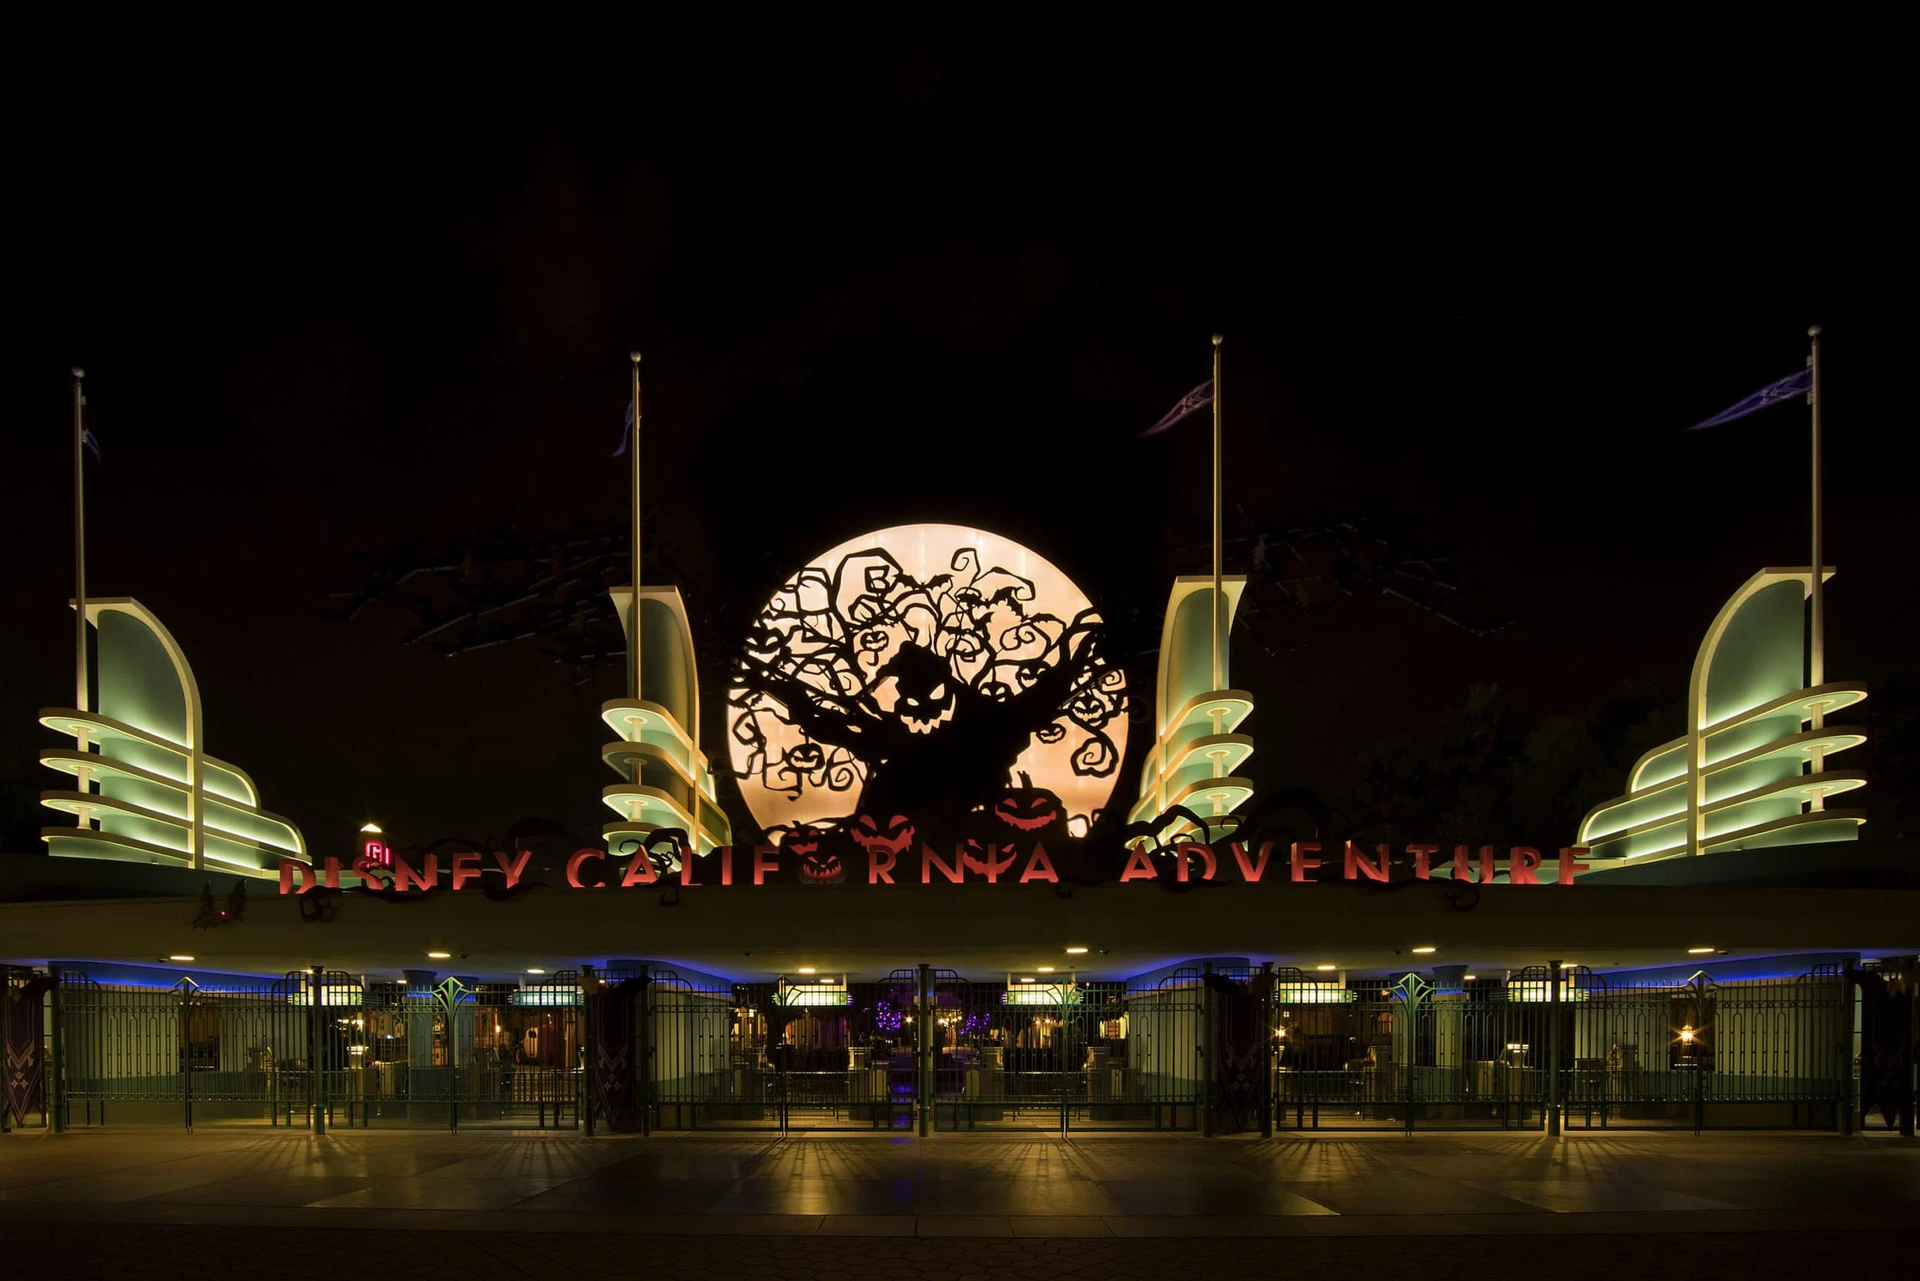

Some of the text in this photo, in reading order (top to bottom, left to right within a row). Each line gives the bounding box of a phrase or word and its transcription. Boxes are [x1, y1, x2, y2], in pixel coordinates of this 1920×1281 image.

[279, 840, 1591, 894] DISNEY CALIFRNIA ADVENTURE
